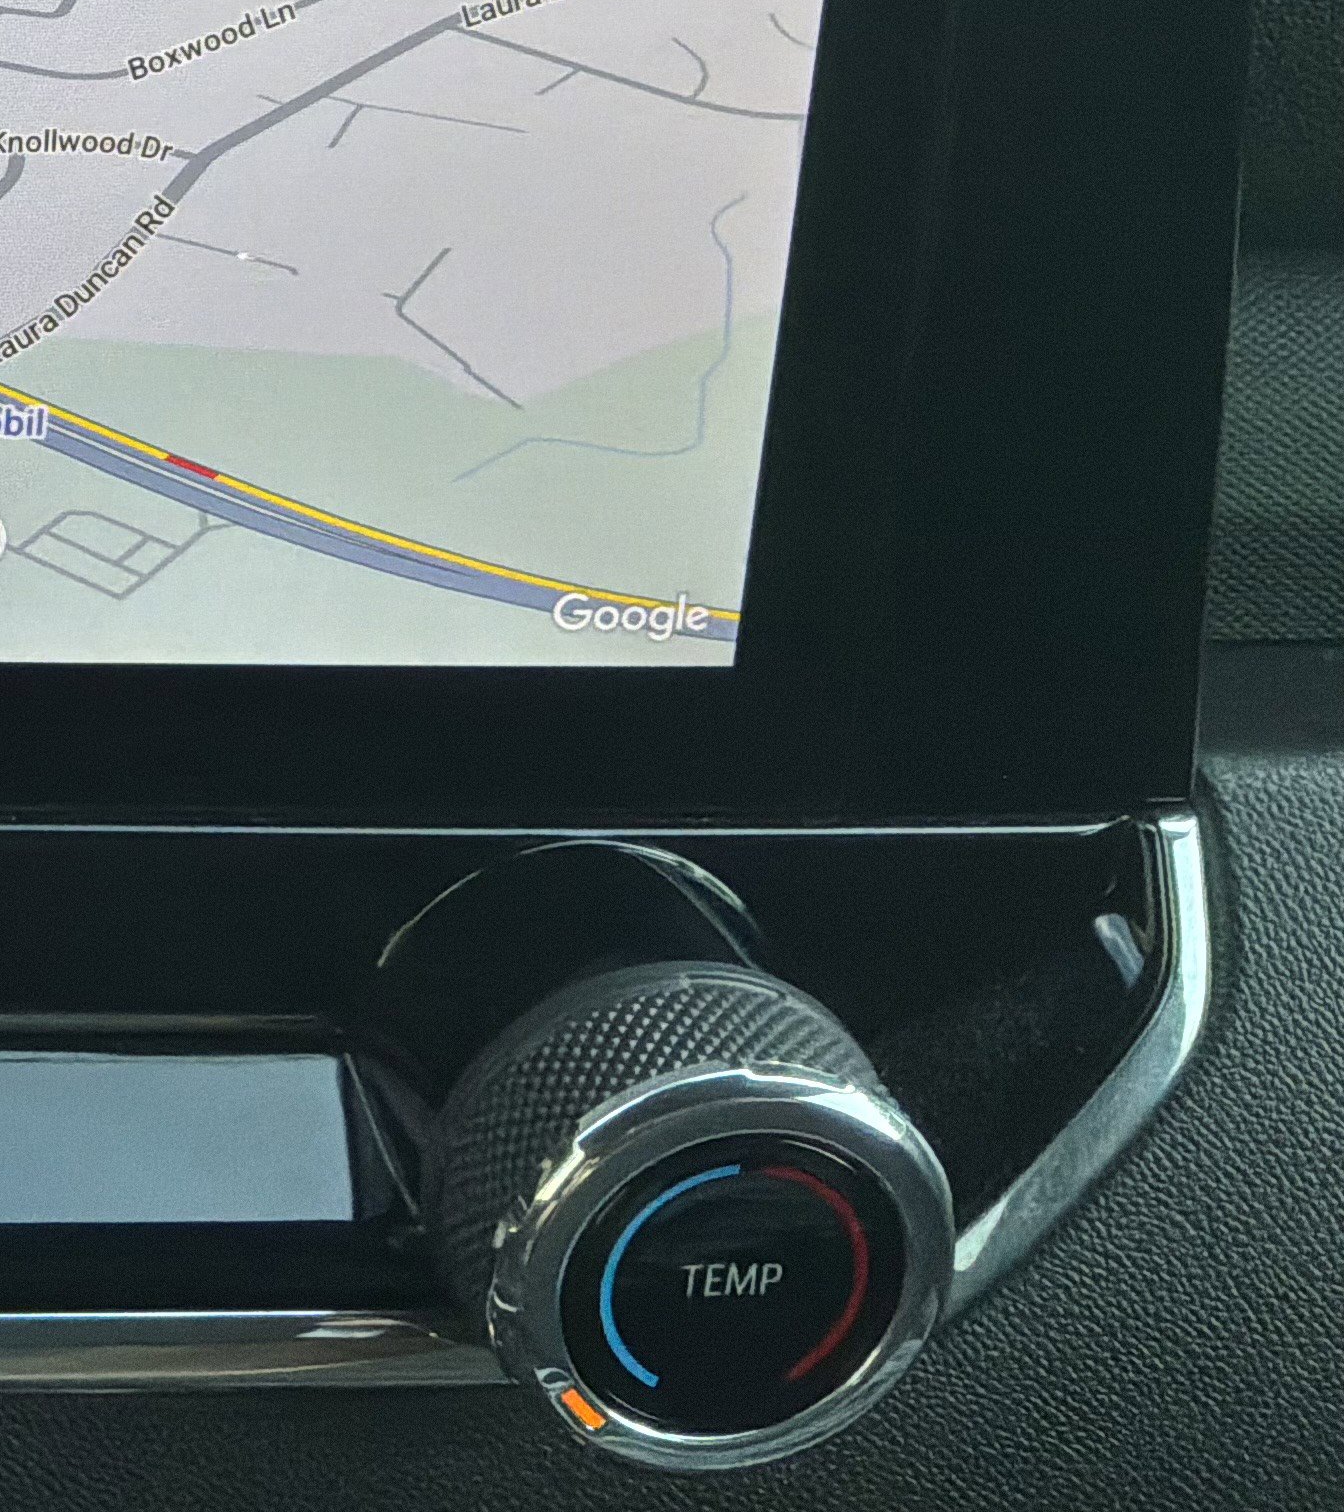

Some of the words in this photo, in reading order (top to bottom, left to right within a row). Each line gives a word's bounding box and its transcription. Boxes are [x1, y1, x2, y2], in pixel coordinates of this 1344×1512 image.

[129, 13, 256, 79] Boxwood
[261, 1, 297, 29] Ln
[140, 138, 174, 161] Dr
[54, 234, 147, 318] Duncan
[135, 194, 177, 236] Rd
[552, 592, 710, 640] Google
[681, 1262, 784, 1297] TEMP
